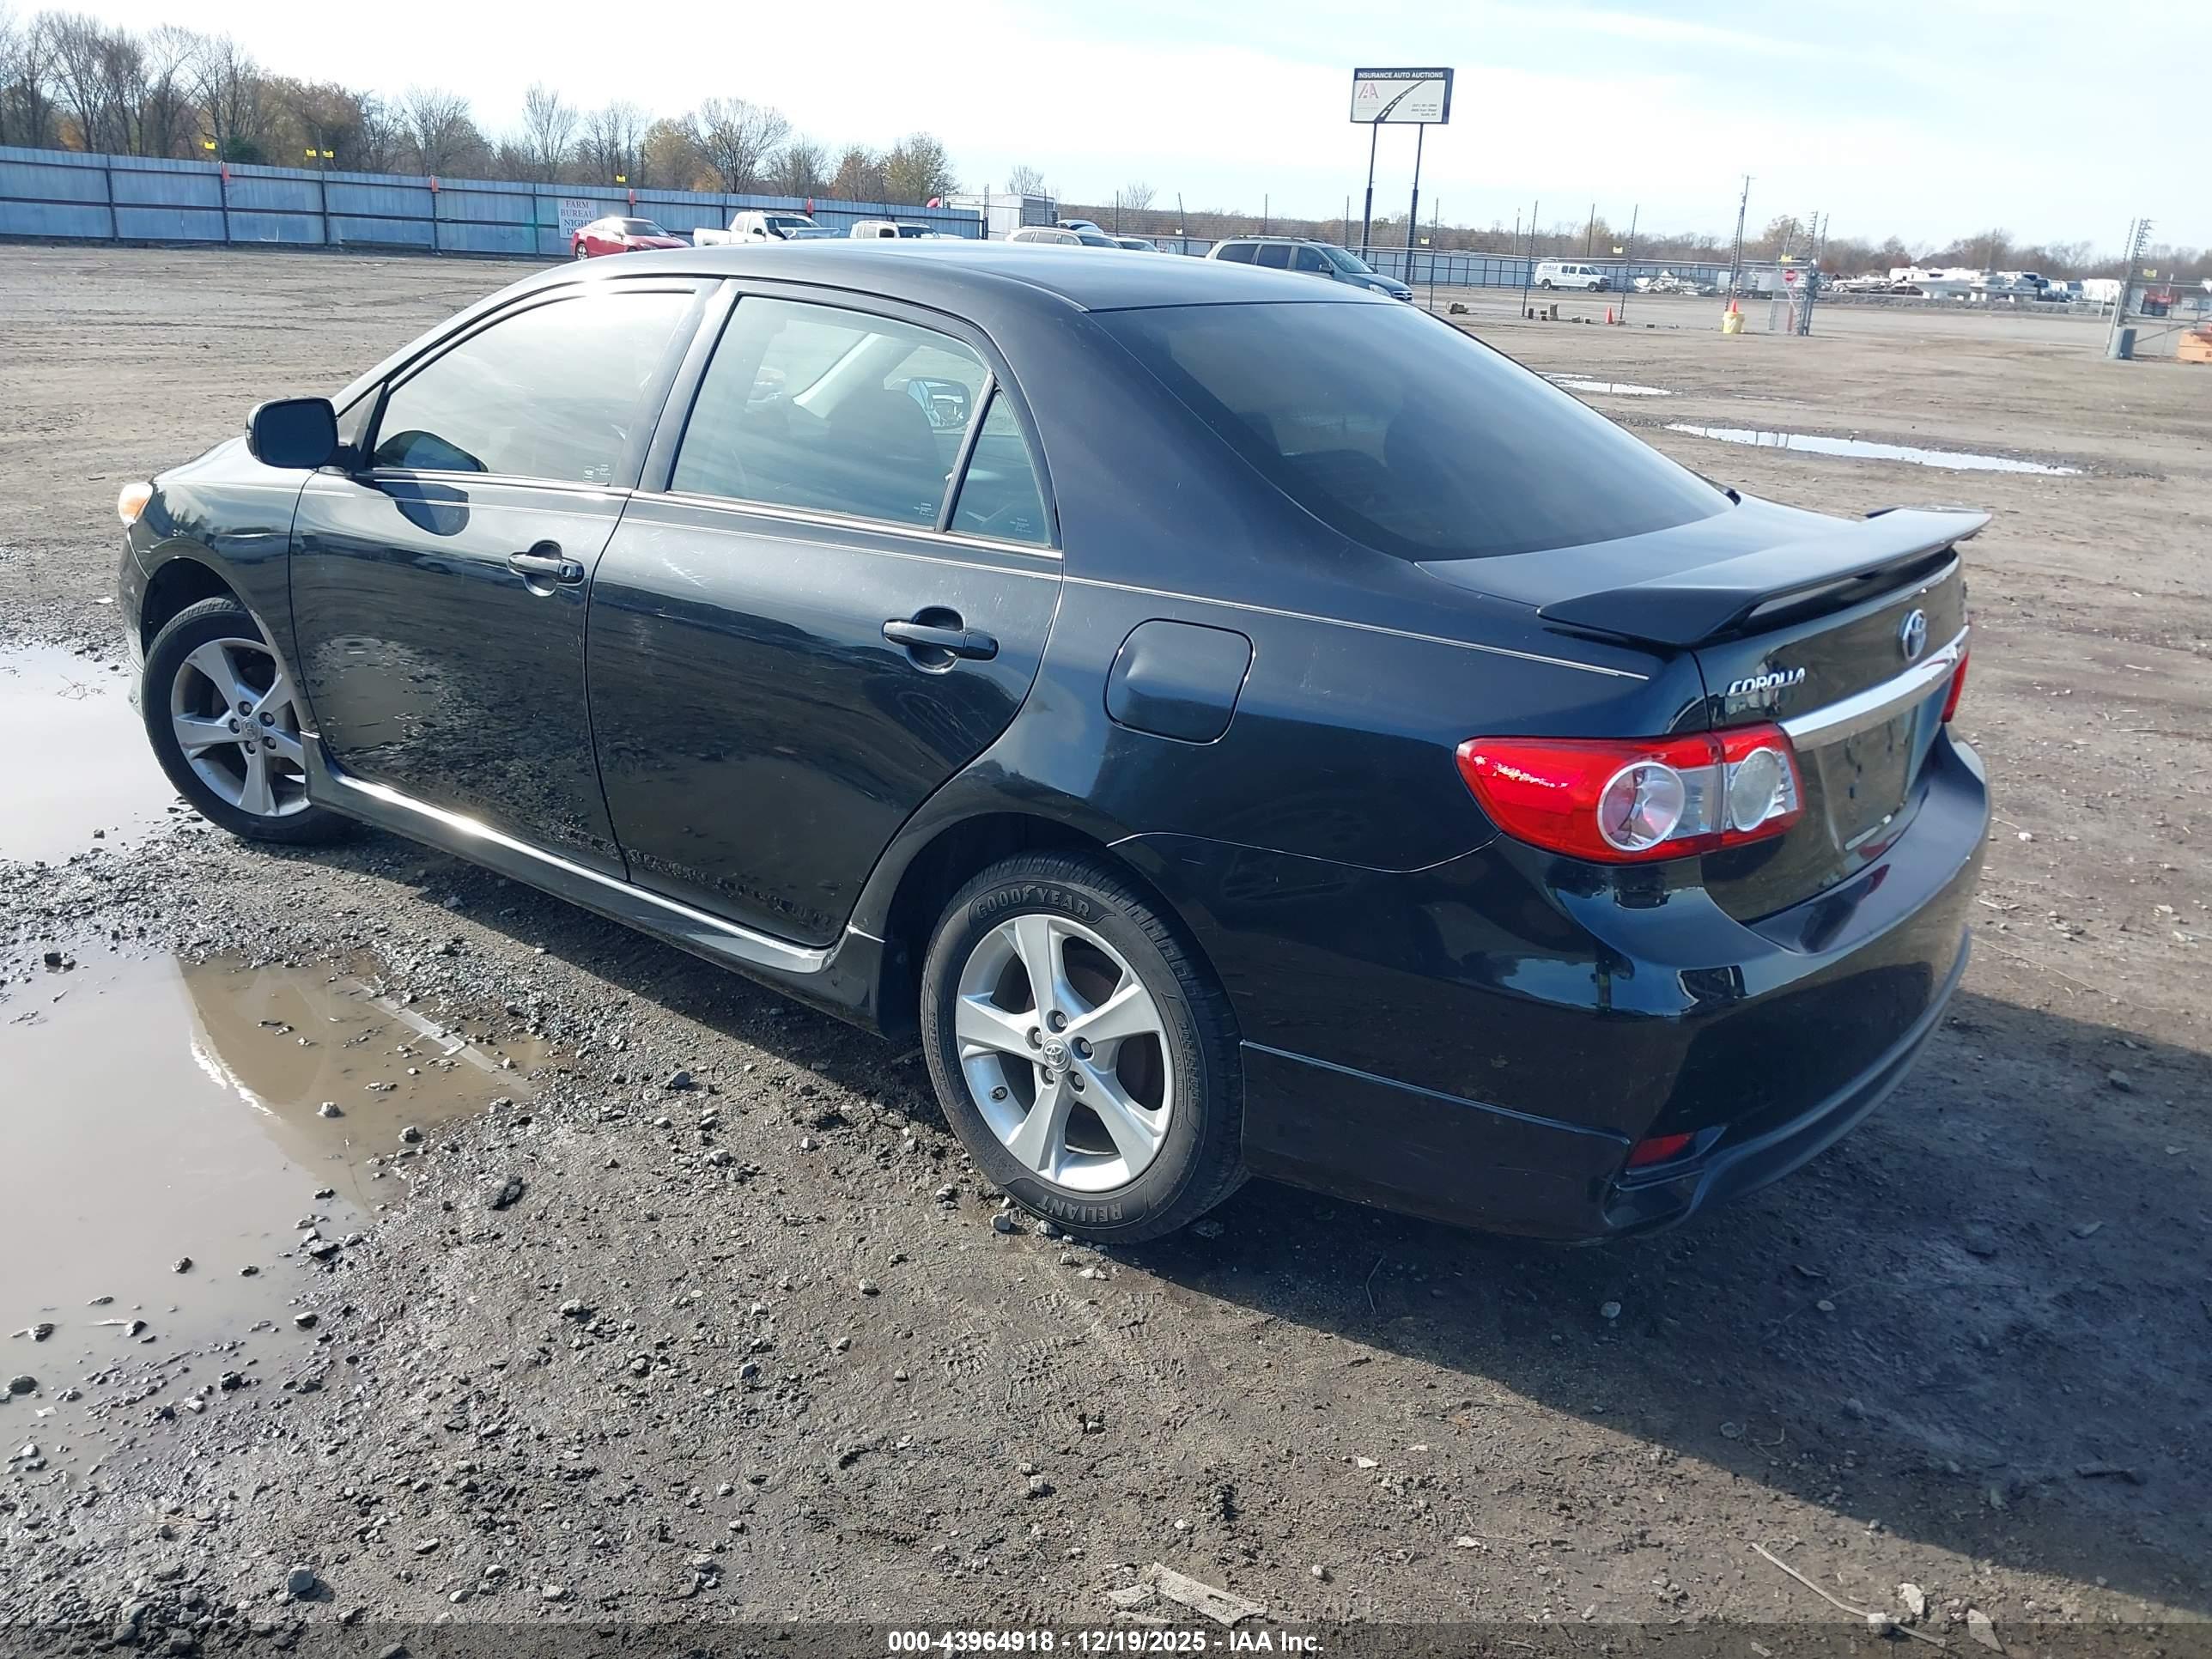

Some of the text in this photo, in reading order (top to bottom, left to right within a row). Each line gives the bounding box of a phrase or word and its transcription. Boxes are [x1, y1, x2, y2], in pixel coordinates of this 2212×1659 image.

[561, 209, 595, 219] BUREAU
[566, 200, 589, 209] FARM
[1726, 667, 1806, 696] COROLLA
[1036, 1194, 1123, 1223] RELIANT
